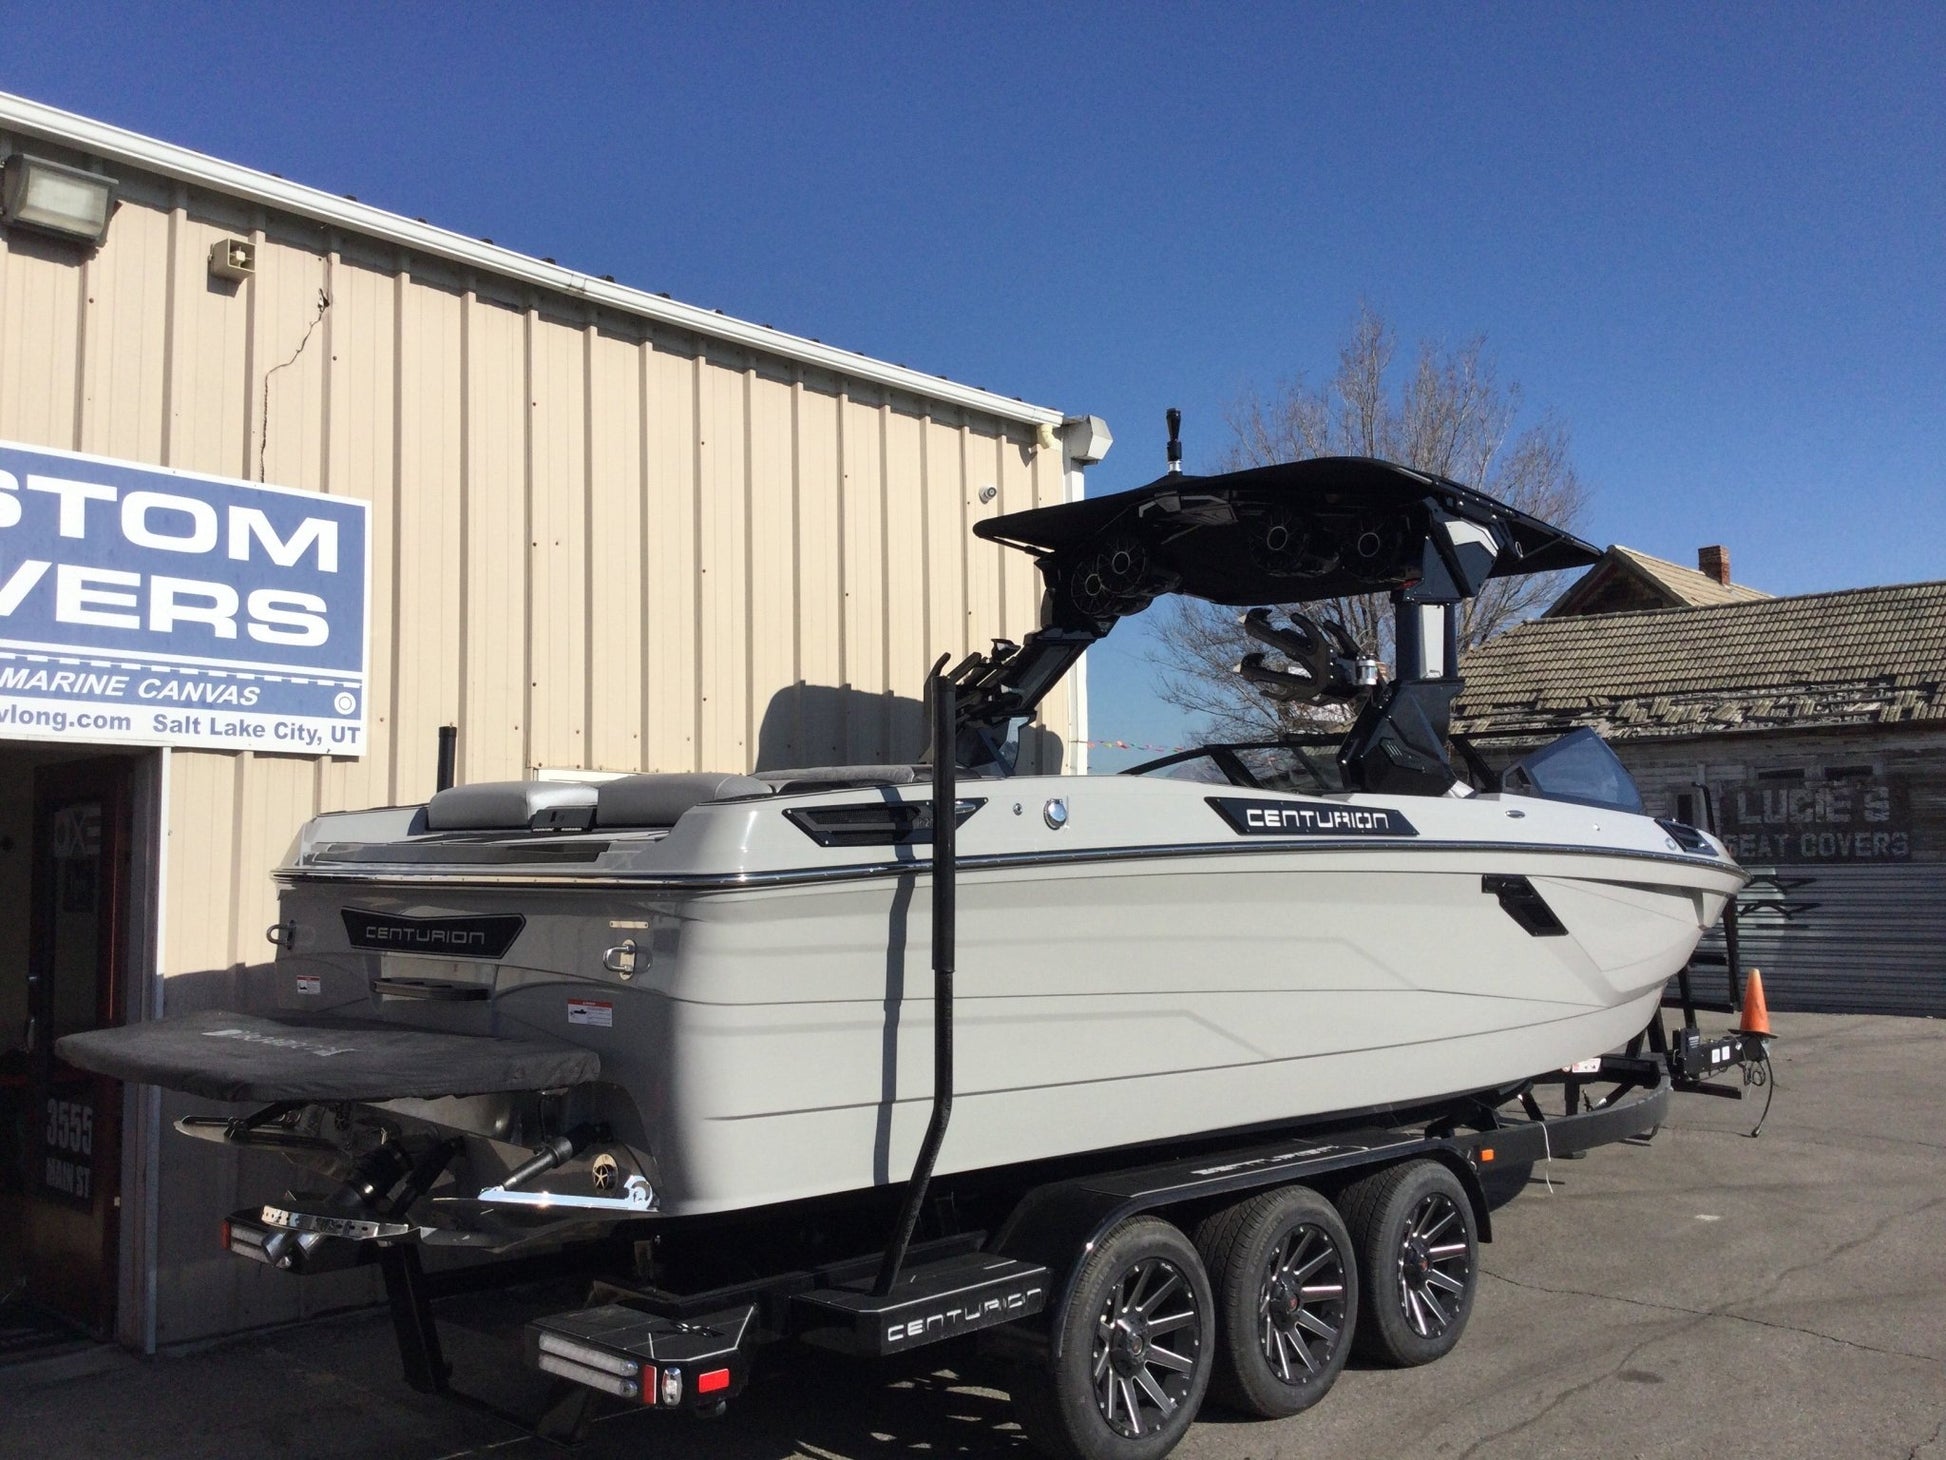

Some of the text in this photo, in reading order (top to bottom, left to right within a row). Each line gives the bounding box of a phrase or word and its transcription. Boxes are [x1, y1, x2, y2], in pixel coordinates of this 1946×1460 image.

[0, 469, 338, 573] TOM
[0, 667, 261, 706] MARINE CANVAS
[153, 714, 201, 735] Salt
[210, 718, 265, 738] Lake
[274, 722, 322, 746] City,
[331, 726, 361, 744] UT
[1246, 808, 1389, 829] CENTURION
[1801, 832, 1910, 857] COVERS
[366, 926, 485, 945] CENTURION
[47, 1098, 93, 1155] 3555
[887, 1287, 1042, 1342] CENTURION
